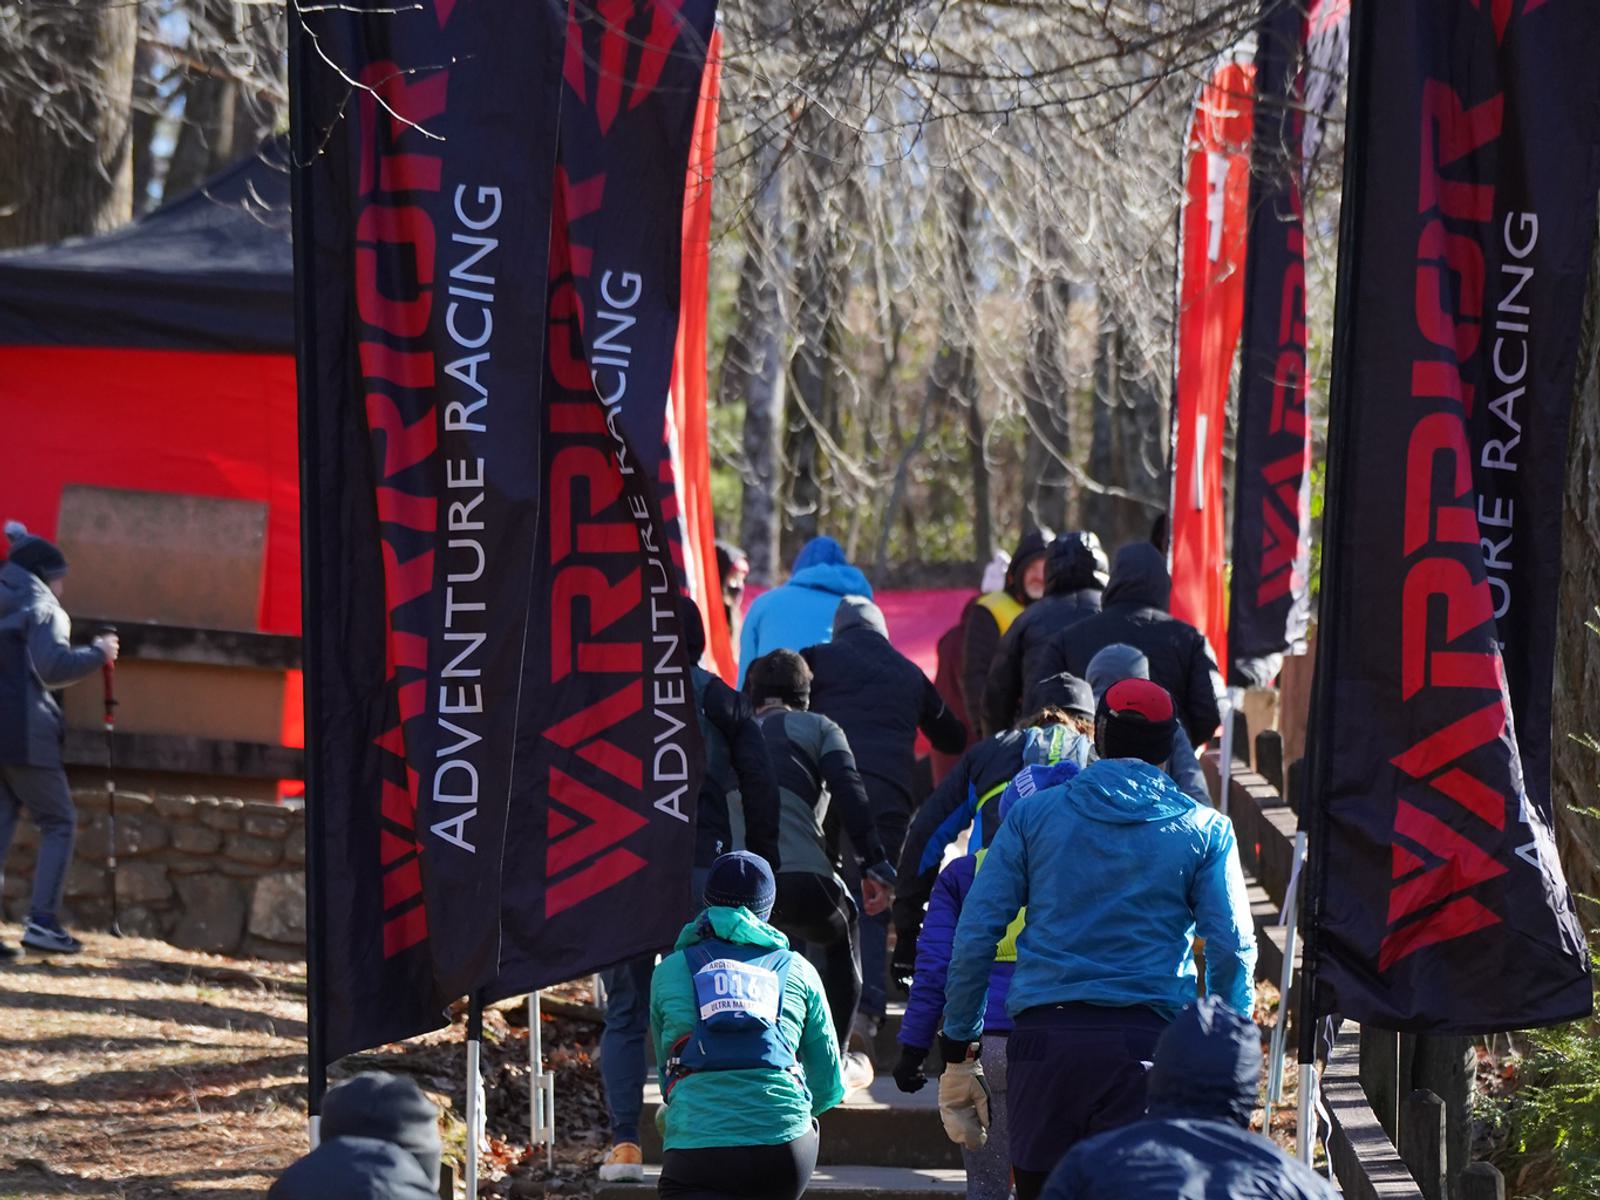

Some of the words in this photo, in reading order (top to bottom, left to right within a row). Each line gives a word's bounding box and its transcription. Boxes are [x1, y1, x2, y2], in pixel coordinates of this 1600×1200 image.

[444, 183, 503, 433] RACING
[591, 269, 643, 475] RACING
[1480, 210, 1540, 472] RACING
[431, 458, 486, 853] ADVENTURE
[1378, 76, 1509, 974] WARRIOR
[628, 493, 689, 823] ADVENTURE
[714, 973, 761, 1000] 016
